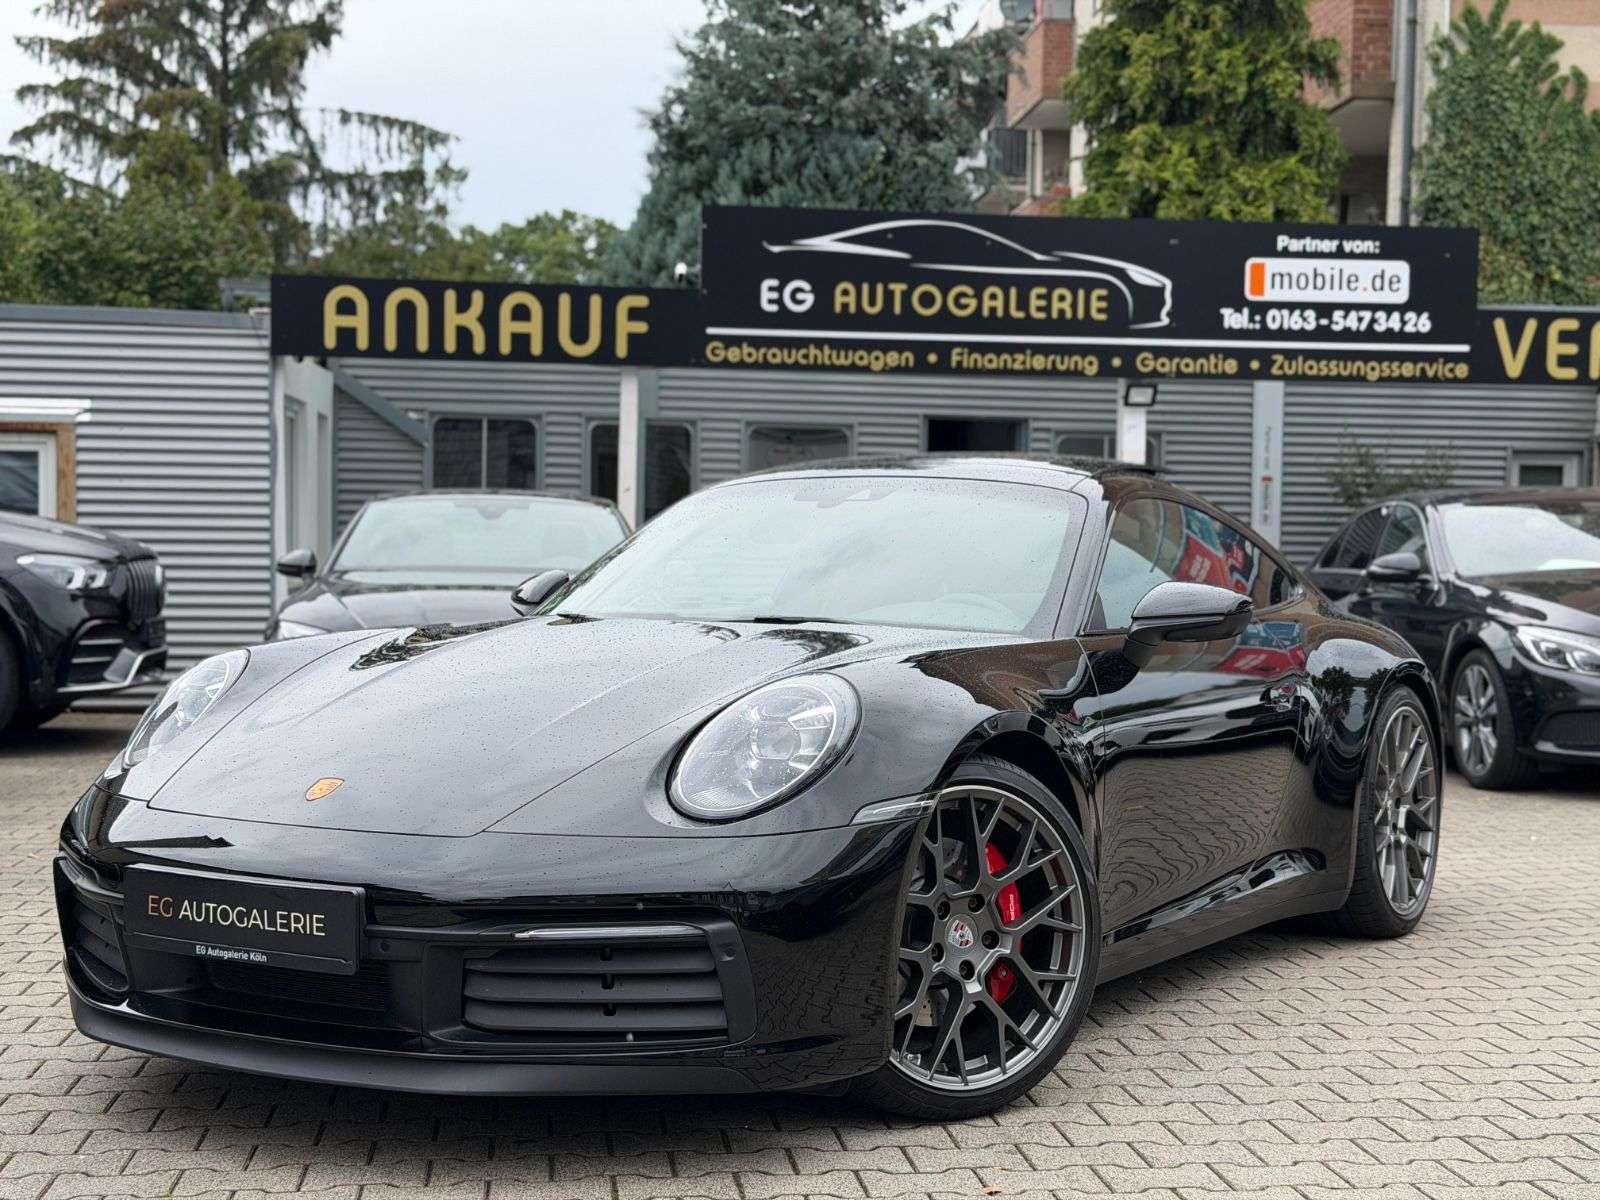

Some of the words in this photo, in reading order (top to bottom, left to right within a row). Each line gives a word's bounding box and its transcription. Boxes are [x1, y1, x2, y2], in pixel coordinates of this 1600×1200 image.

[1276, 234, 1340, 253] Partner
[1342, 239, 1380, 254] von:
[760, 278, 815, 313] EG
[833, 281, 1110, 321] AUTOGALERIE
[1270, 267, 1402, 293] mobile.de
[323, 284, 650, 359] ANKAUF
[1219, 308, 1261, 330] Tel.:
[705, 340, 915, 372] Gebrauchtwagen
[950, 347, 1100, 376] Finanzierung
[1135, 351, 1238, 375] Garantie
[1270, 354, 1470, 382] Zulassungsservice
[1493, 317, 1600, 380] VE
[148, 894, 173, 918] EG
[178, 899, 326, 936] AUTOGALERIE
[195, 944, 206, 955] EG
[207, 945, 249, 961] Autogalerie
[249, 951, 268, 963] Köln
